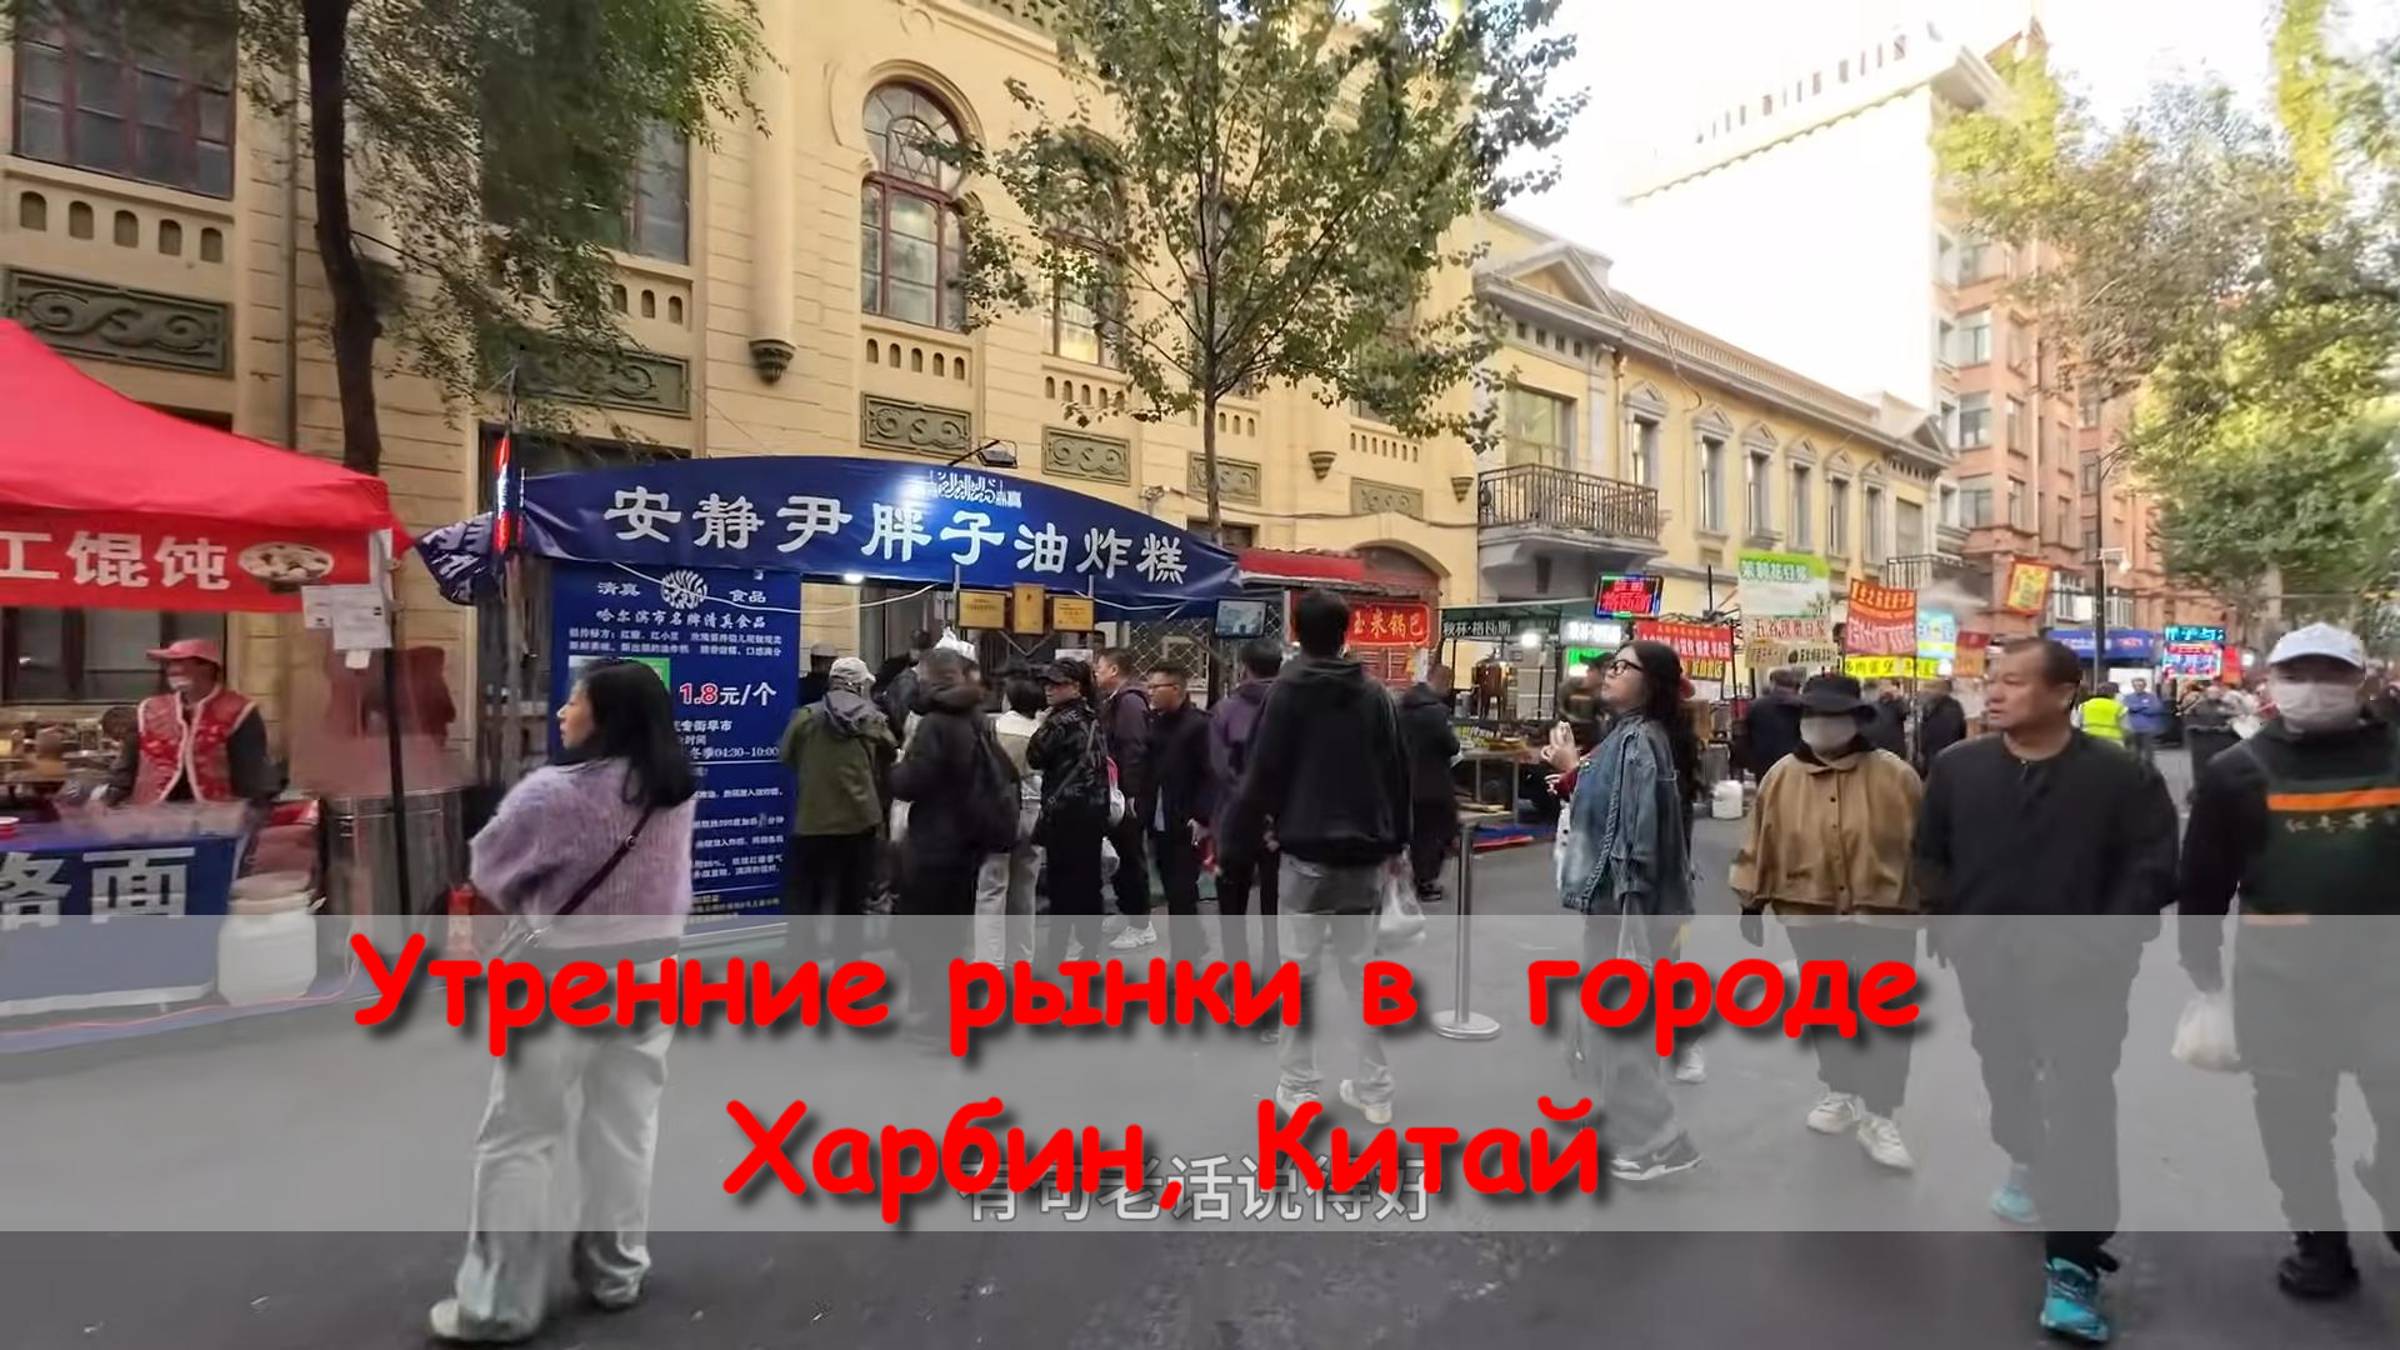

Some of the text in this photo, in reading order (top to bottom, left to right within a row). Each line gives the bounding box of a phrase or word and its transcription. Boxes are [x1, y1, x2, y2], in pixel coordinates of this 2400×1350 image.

[604, 486, 1188, 584] 安静尹胖子油炸糕
[597, 581, 766, 603] 清真 食品
[1353, 609, 1424, 640] 玉米锅巴
[679, 681, 777, 706] 1.8元/个
